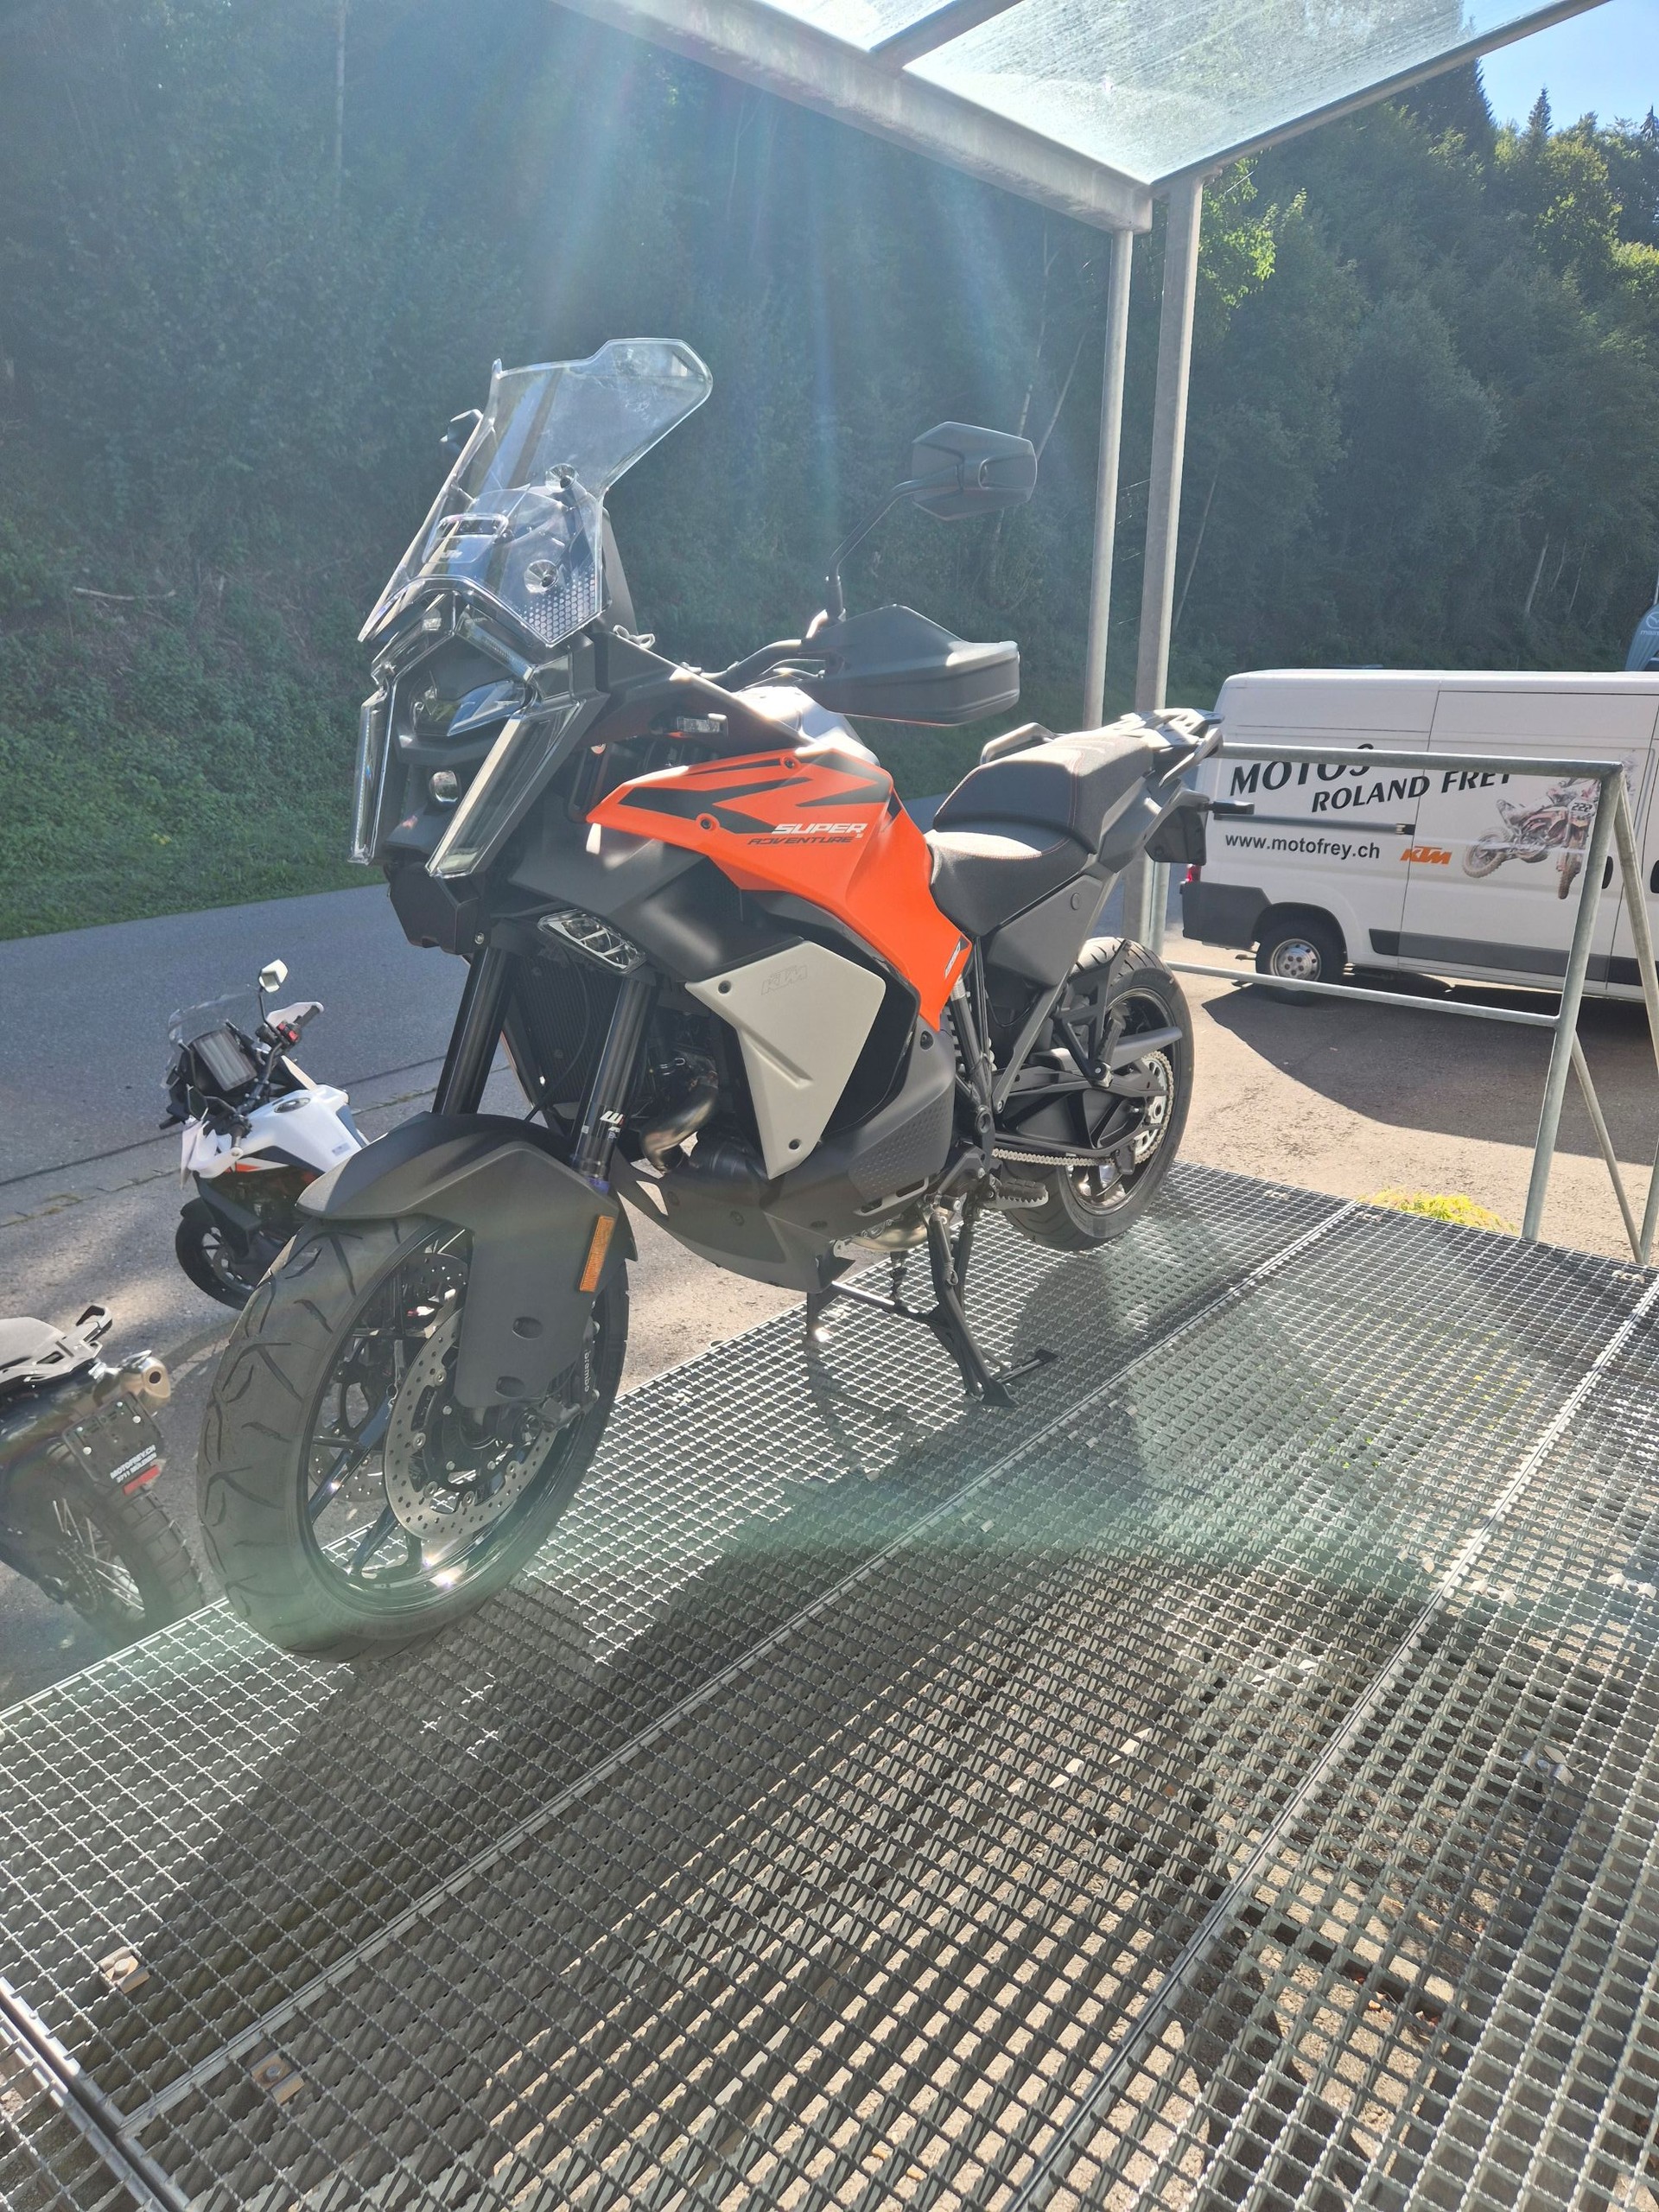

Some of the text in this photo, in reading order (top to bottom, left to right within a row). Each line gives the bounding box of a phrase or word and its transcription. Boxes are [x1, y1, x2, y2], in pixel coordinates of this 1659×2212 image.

[1312, 776, 1431, 813] ROLAND
[1571, 802, 1593, 813] 222
[771, 823, 868, 835] SUPER
[747, 836, 855, 845] ADVENTURE
[1224, 834, 1381, 861] www.motofrey.ch
[1399, 845, 1453, 865] KTM
[760, 964, 809, 995] KTM
